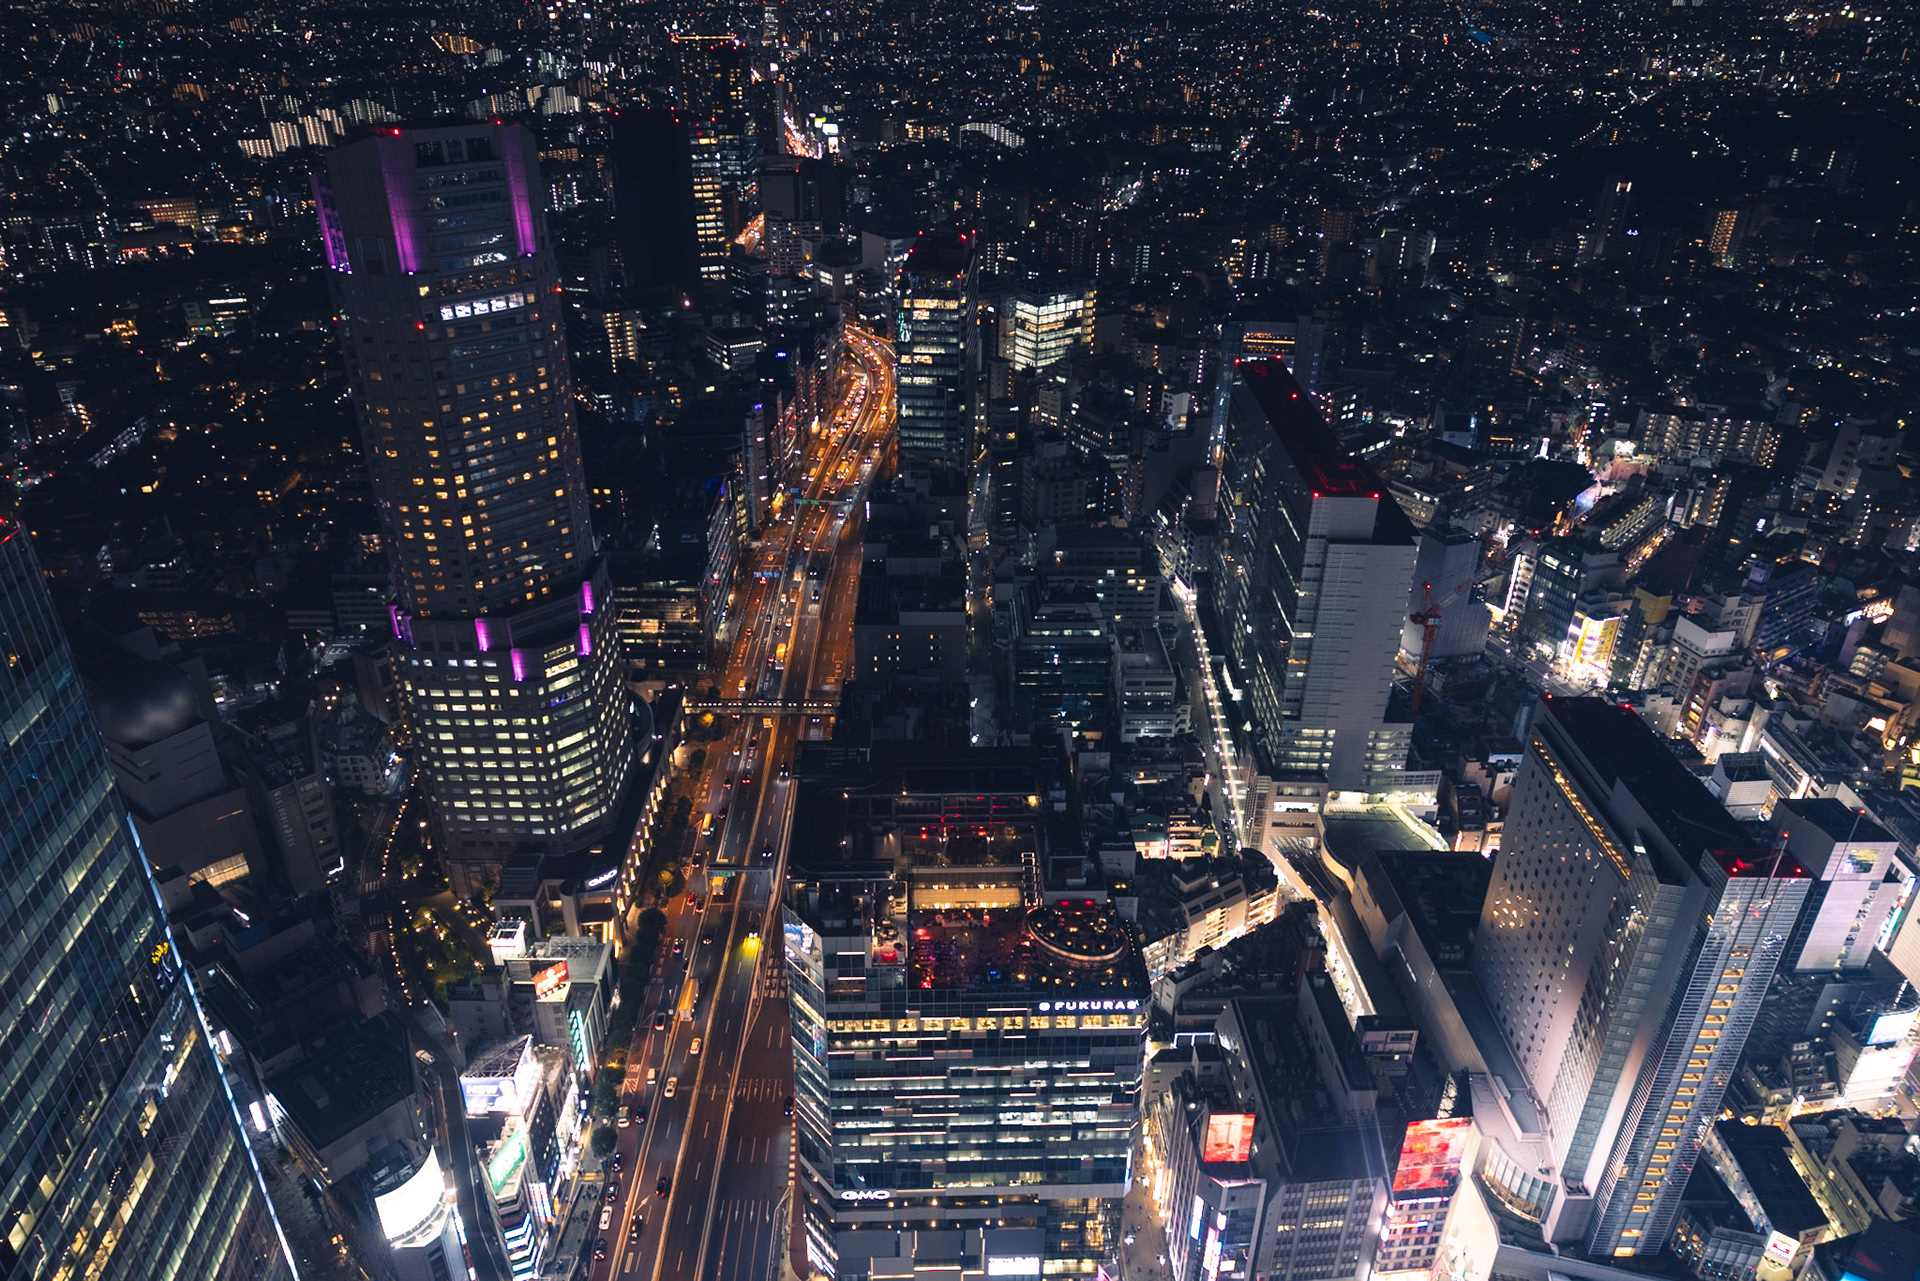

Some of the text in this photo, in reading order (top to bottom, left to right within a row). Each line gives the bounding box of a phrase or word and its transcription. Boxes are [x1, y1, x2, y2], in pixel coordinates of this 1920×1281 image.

[588, 869, 618, 887] GMO
[1054, 1000, 1137, 1011] FUKURAS
[840, 1190, 891, 1201] GMO
